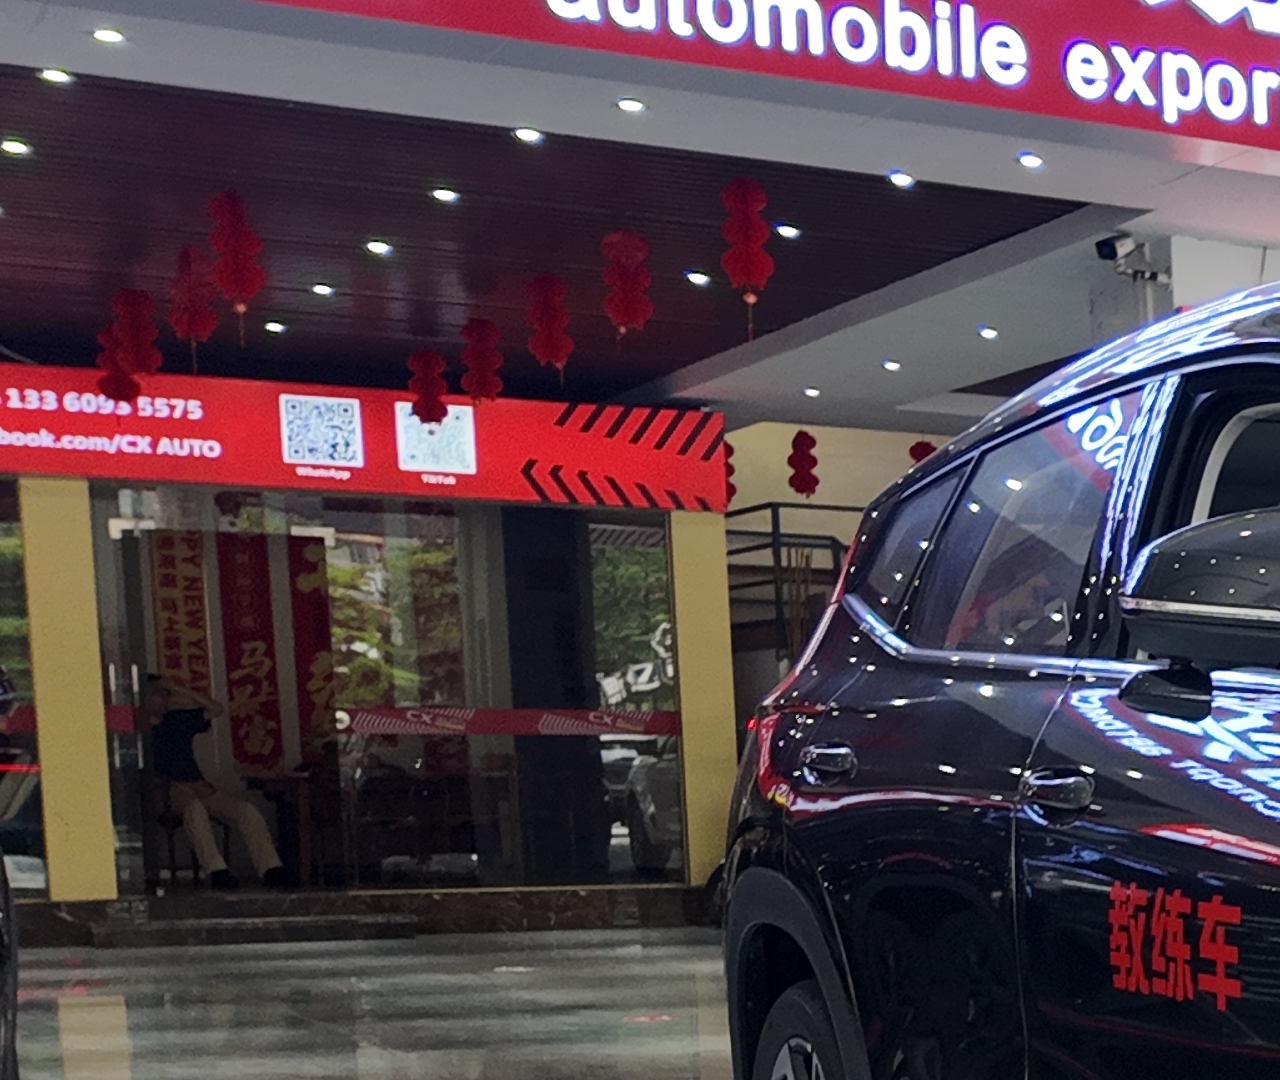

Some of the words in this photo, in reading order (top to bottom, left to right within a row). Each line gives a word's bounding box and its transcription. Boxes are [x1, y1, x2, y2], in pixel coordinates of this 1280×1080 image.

[5, 387, 59, 411] 133
[137, 396, 204, 420] 5575
[156, 437, 224, 459] AUTO
[1108, 879, 1242, 1012] 教练车
